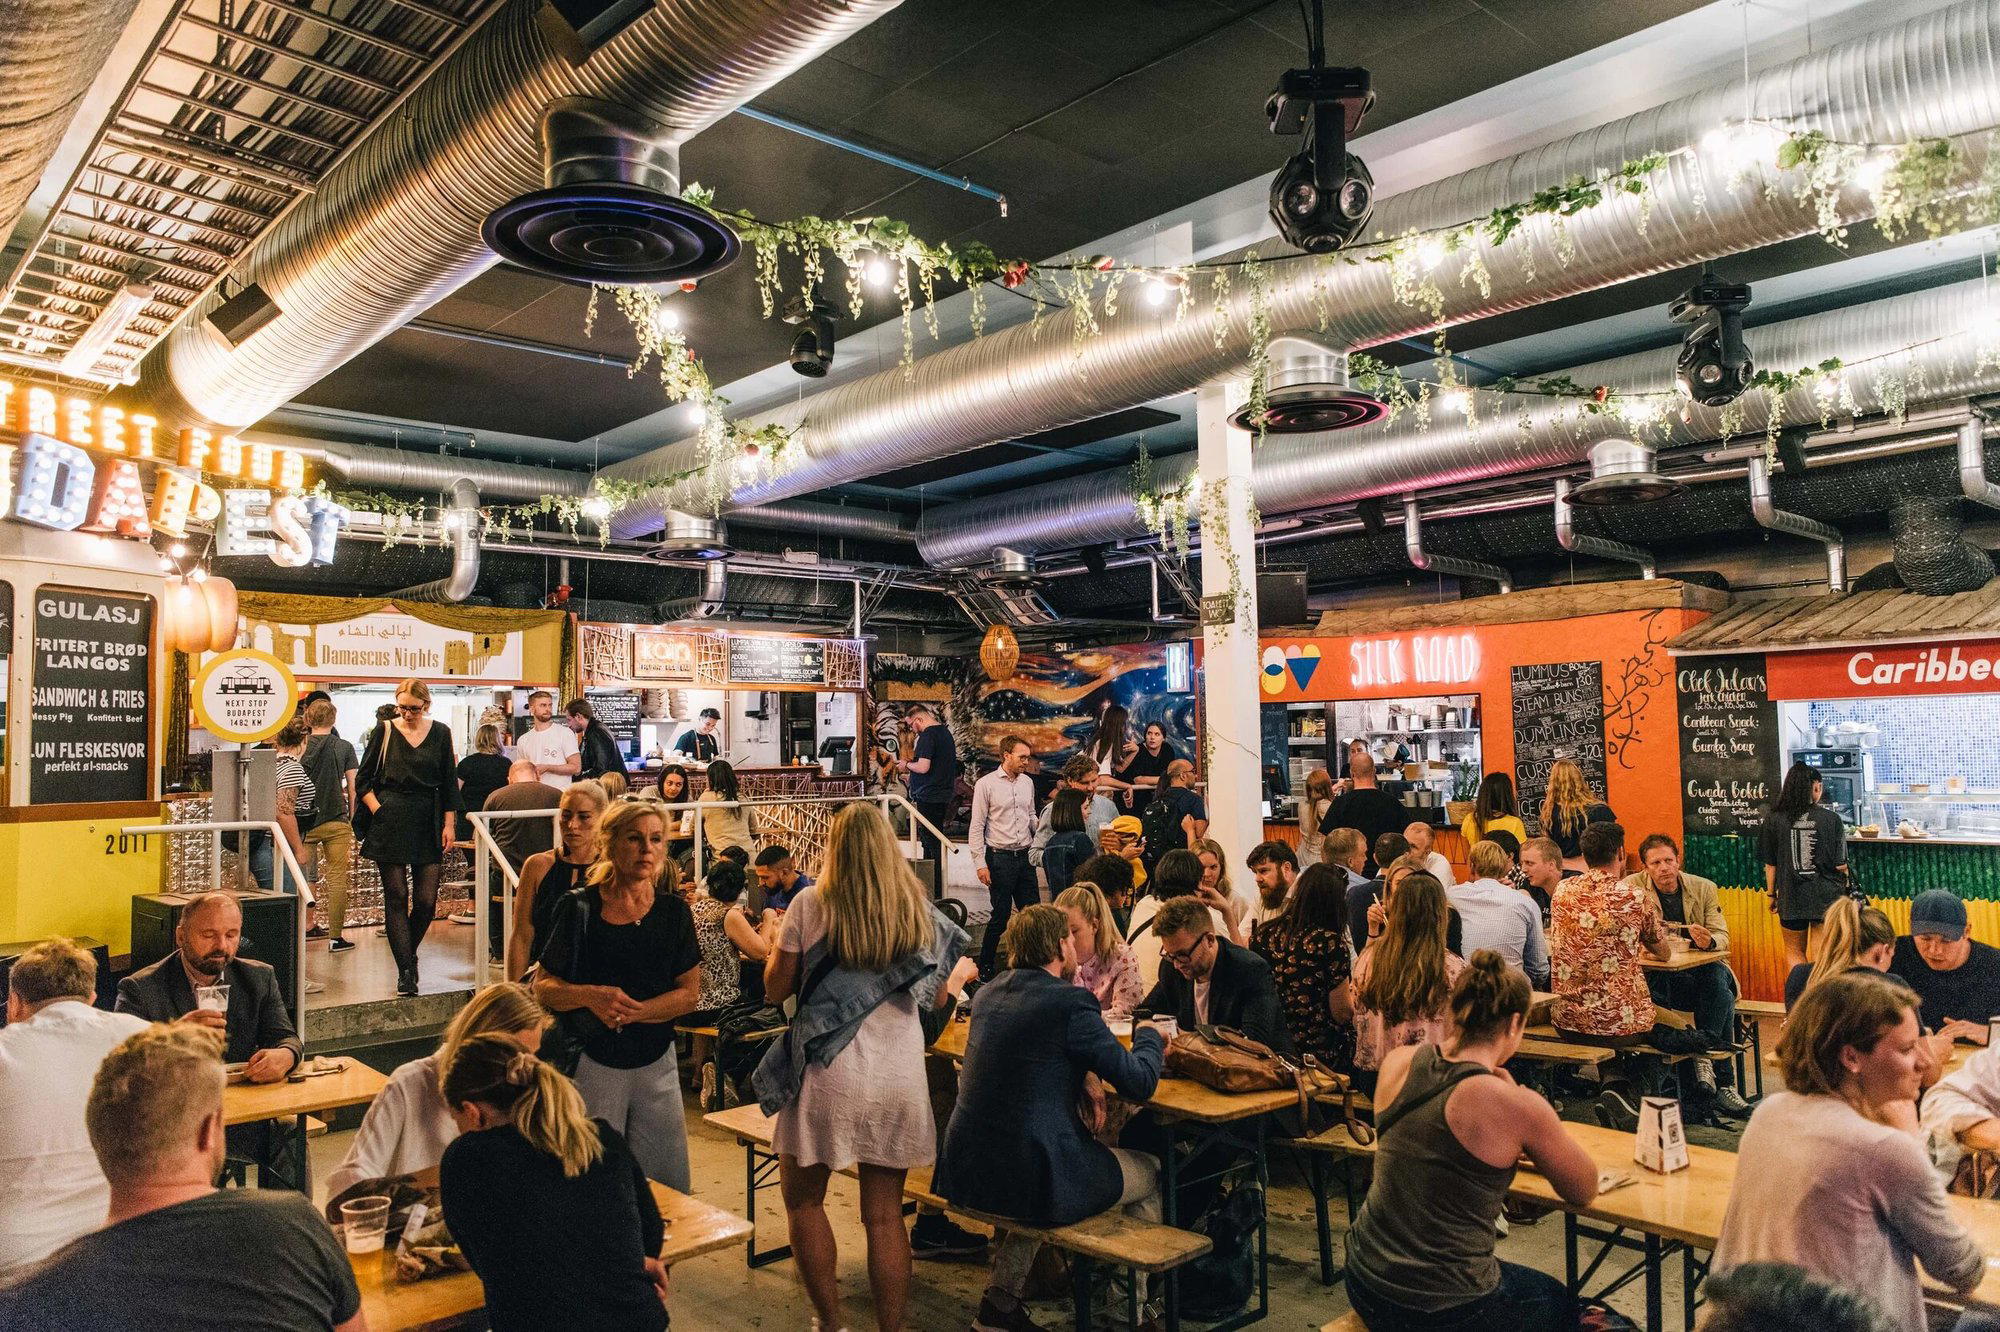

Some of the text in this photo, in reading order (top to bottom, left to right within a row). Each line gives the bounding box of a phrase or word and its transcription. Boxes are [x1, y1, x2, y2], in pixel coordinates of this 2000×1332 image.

[177, 427, 304, 489] FOOD
[0, 432, 351, 567] DAPEST
[37, 599, 141, 625] GULASJ
[104, 642, 148, 657] BRØD
[321, 644, 439, 670] Damascus Nights
[46, 654, 131, 671] LANGOS
[1350, 636, 1474, 688] SILK ROAD
[1511, 664, 1570, 682] HUMMUS
[1678, 669, 1712, 693] Chef
[32, 687, 145, 708] SANDWICH & FRIES
[1513, 695, 1549, 713] STEAM
[1554, 689, 1583, 708] BUNS
[32, 713, 57, 722] Messy
[59, 713, 73, 723] Pig
[87, 714, 122, 722] Konfitert
[227, 709, 266, 717] BUDAPEST
[1513, 717, 1597, 745] DUMPLINGS
[59, 742, 145, 758] FLESKESVOR
[1692, 737, 1755, 756] Gumbo Soup
[45, 761, 81, 774] perfekt
[1516, 760, 1553, 780] CURR
[1517, 800, 1535, 817] ICE
[105, 833, 148, 855] 2011
